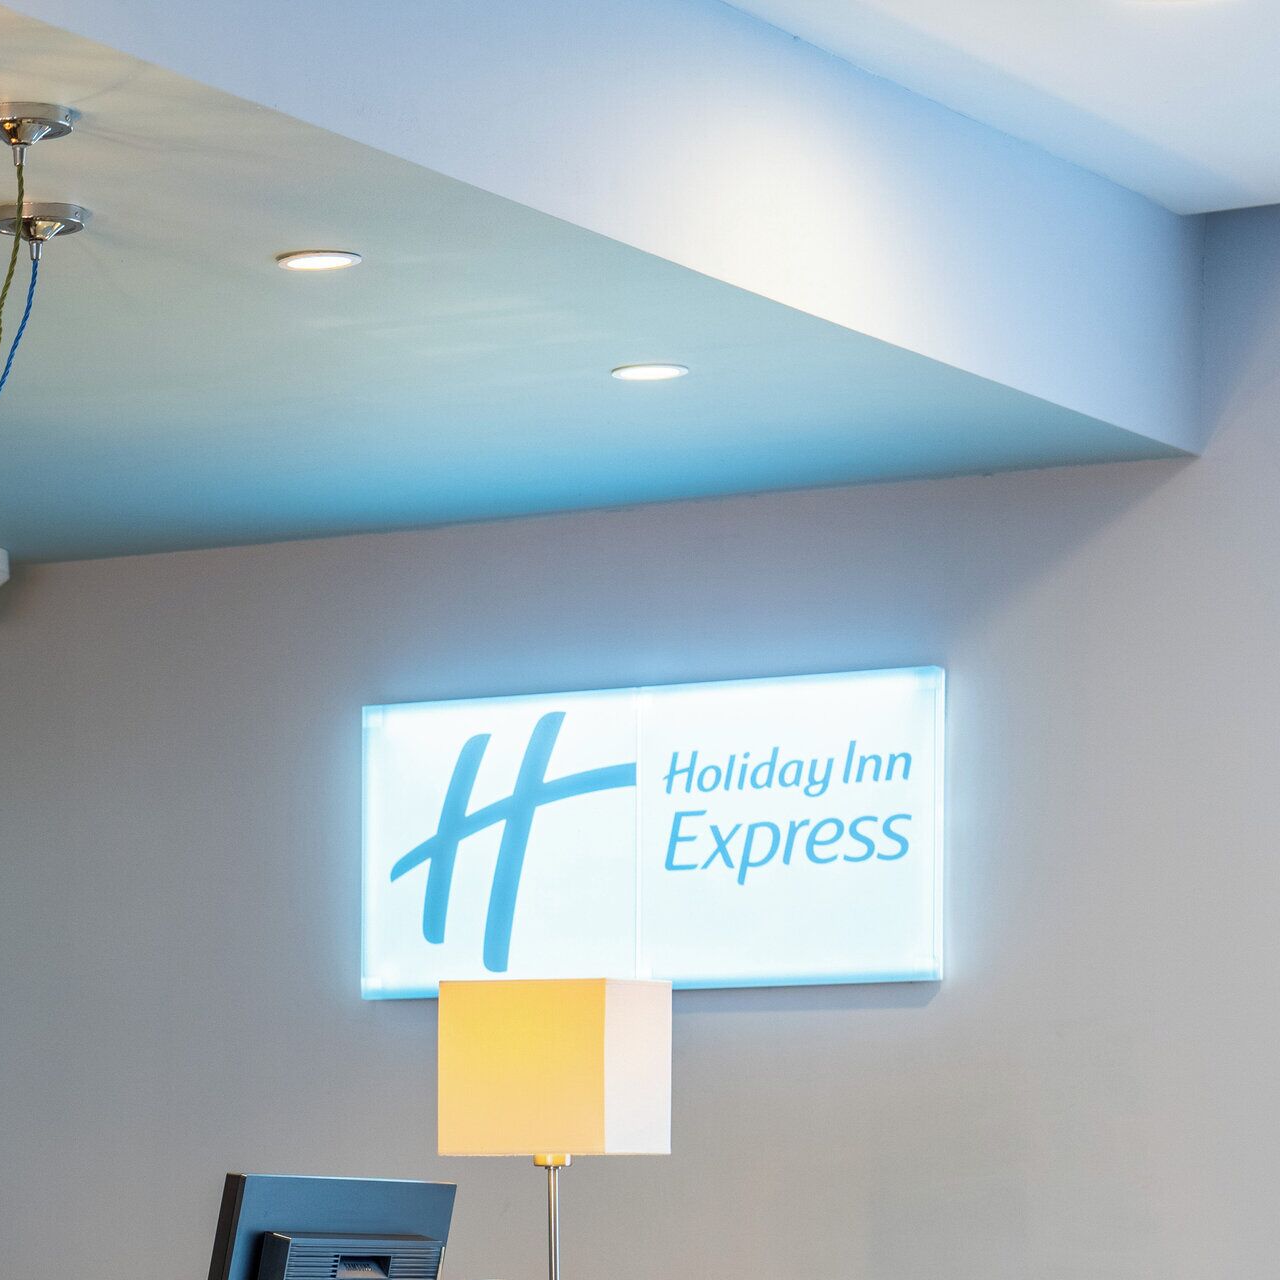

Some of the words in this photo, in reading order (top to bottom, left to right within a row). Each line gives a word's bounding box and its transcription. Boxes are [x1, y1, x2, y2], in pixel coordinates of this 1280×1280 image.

[663, 746, 835, 798] Holiday
[842, 740, 912, 784] Inn
[664, 810, 912, 886] Express
